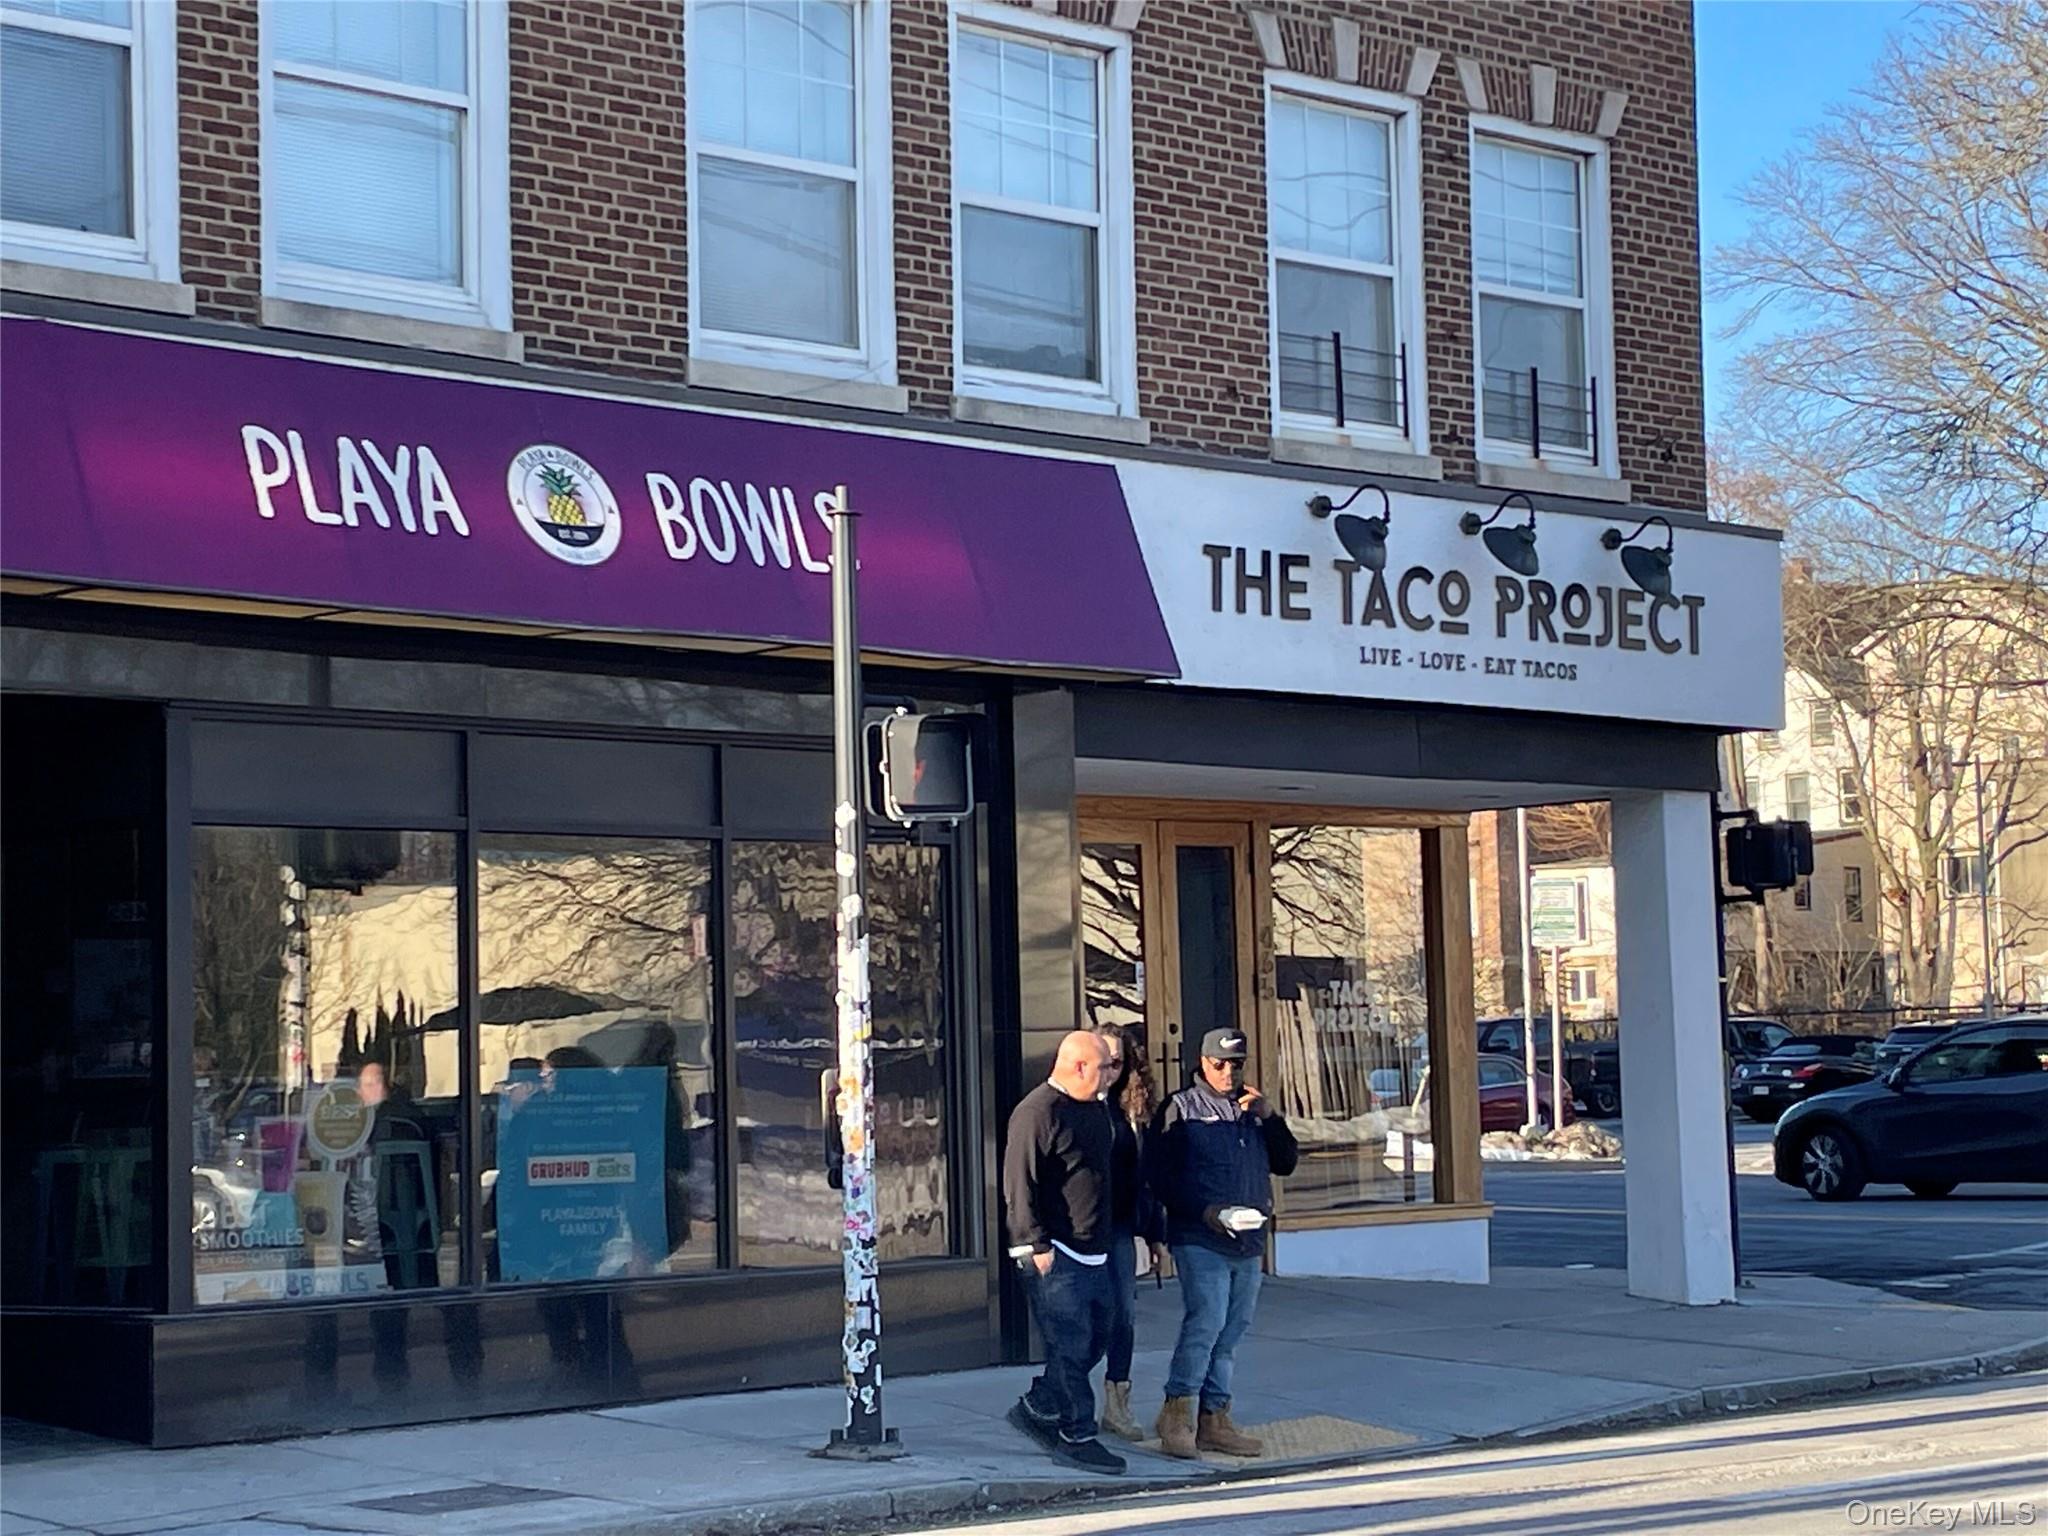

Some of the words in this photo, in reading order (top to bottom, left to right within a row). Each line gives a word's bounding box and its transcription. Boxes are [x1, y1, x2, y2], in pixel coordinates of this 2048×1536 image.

[241, 424, 471, 536] PLAYA
[1202, 543, 1311, 620] THE
[1332, 558, 1471, 635] TACO
[1495, 575, 1706, 655] PROJECT
[1359, 645, 1402, 666] LIVE
[1420, 651, 1466, 671] LOVE
[1484, 656, 1517, 675] EAT
[1522, 660, 1578, 681] TACOS
[530, 1160, 590, 1179] GRUBHUB
[597, 1163, 631, 1178] eats
[559, 1222, 608, 1238] FAMILY
